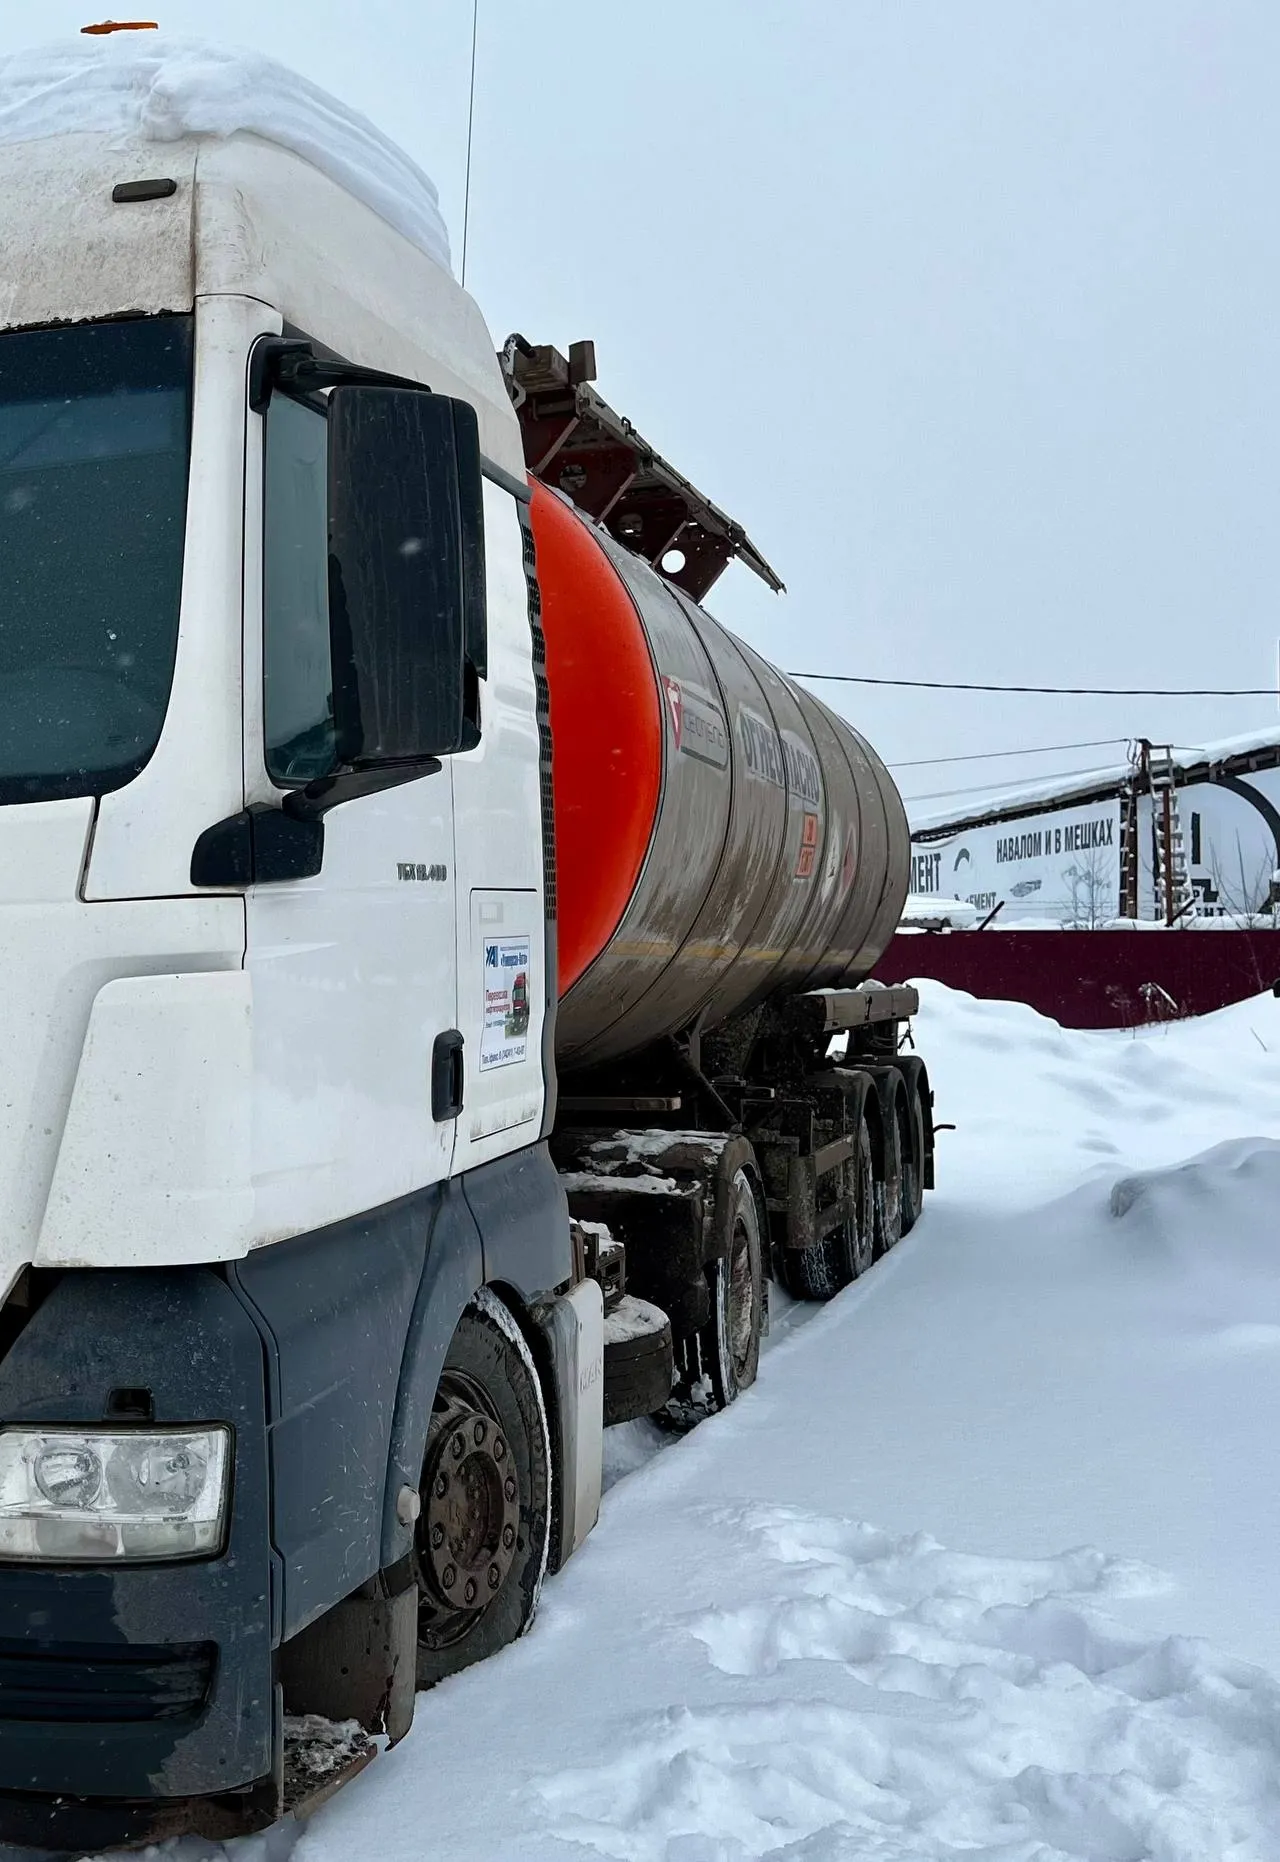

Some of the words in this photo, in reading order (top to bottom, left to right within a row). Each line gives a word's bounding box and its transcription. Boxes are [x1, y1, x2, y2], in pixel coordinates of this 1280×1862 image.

[996, 831, 1042, 864] НАВАЛОМ
[1045, 829, 1052, 856] И
[1054, 828, 1061, 854] В
[1064, 818, 1113, 852] МЕШКАХ
